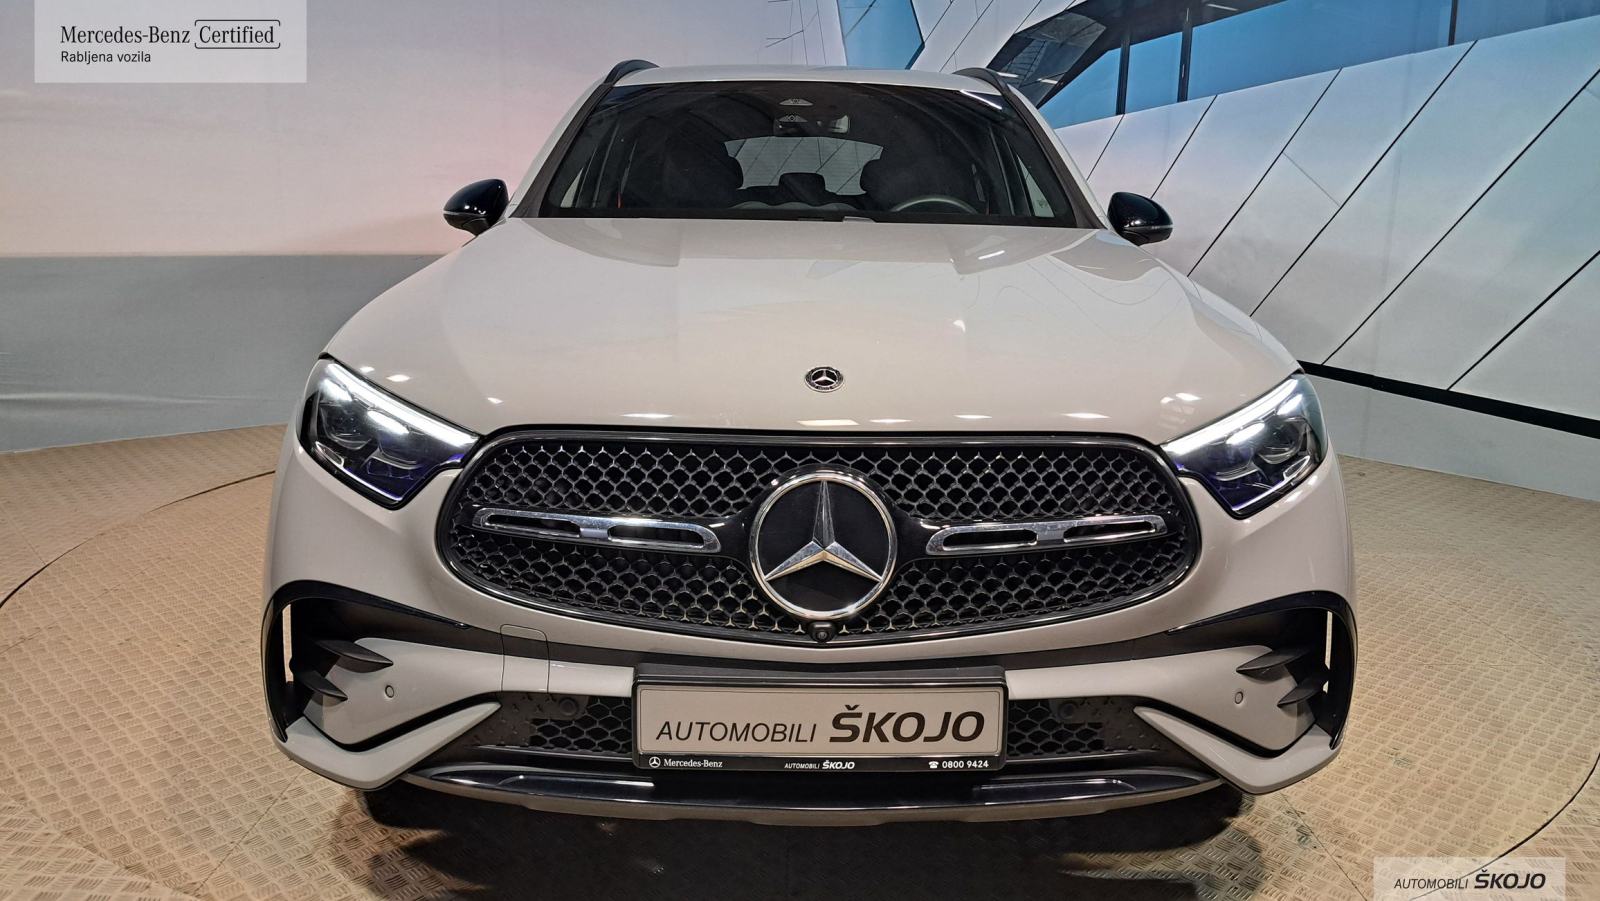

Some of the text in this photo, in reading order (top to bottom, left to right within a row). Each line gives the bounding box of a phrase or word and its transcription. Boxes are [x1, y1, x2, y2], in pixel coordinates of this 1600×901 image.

[655, 704, 985, 743] AUTOMOBILI ŠKOJO
[663, 758, 723, 768] Mercedes-Benz
[822, 760, 856, 770] ŠKOJO
[942, 760, 989, 769] 0800 9424
